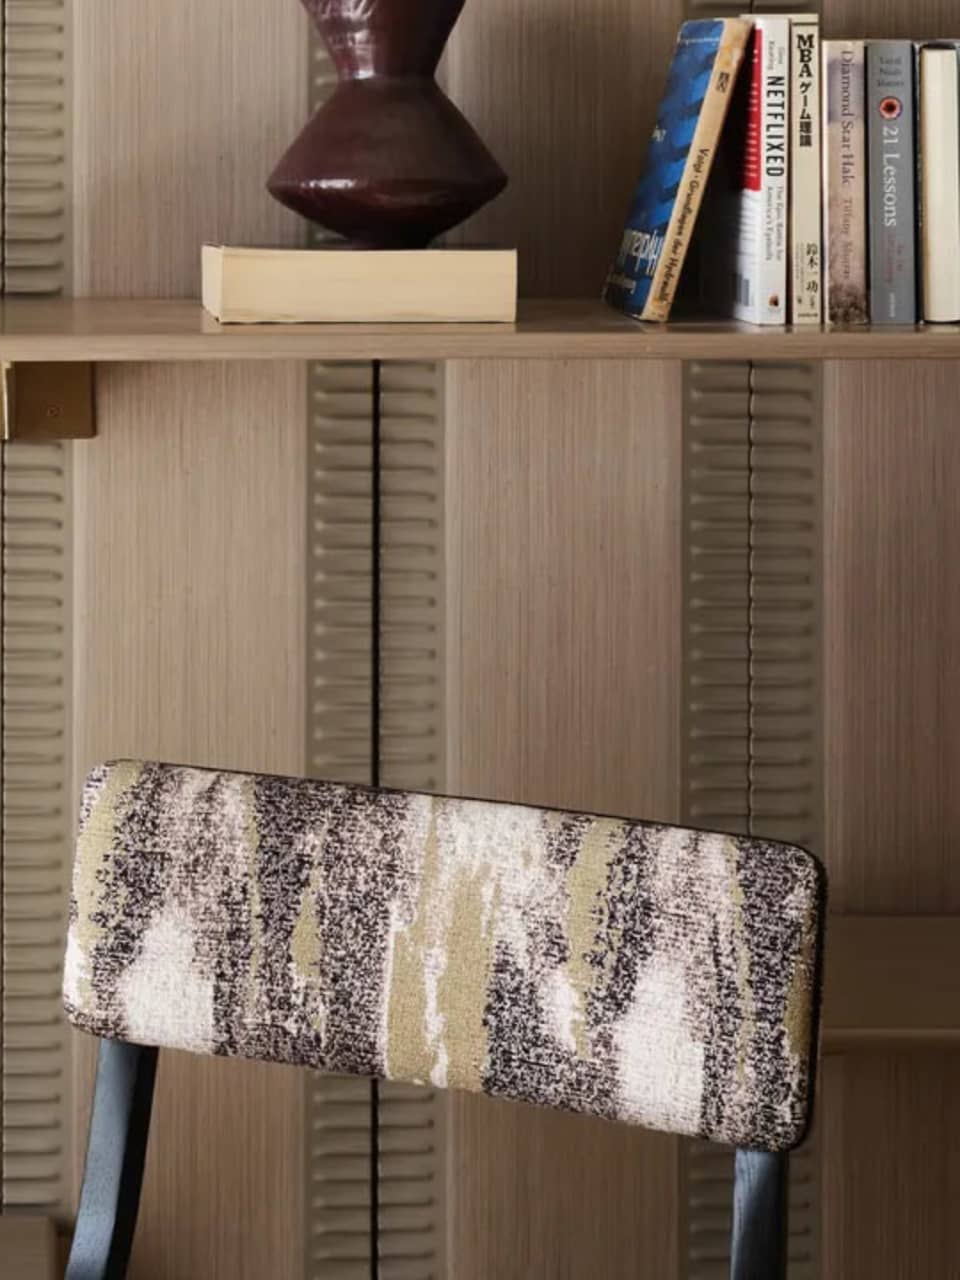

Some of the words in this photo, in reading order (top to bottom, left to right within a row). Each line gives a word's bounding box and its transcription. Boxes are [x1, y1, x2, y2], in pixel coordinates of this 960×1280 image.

[796, 33, 815, 78] MBA
[841, 50, 855, 116] Diamond
[766, 75, 785, 176] NETFLIXED
[841, 120, 855, 149] Star
[882, 126, 899, 144] 21
[883, 153, 900, 227] Lessons
